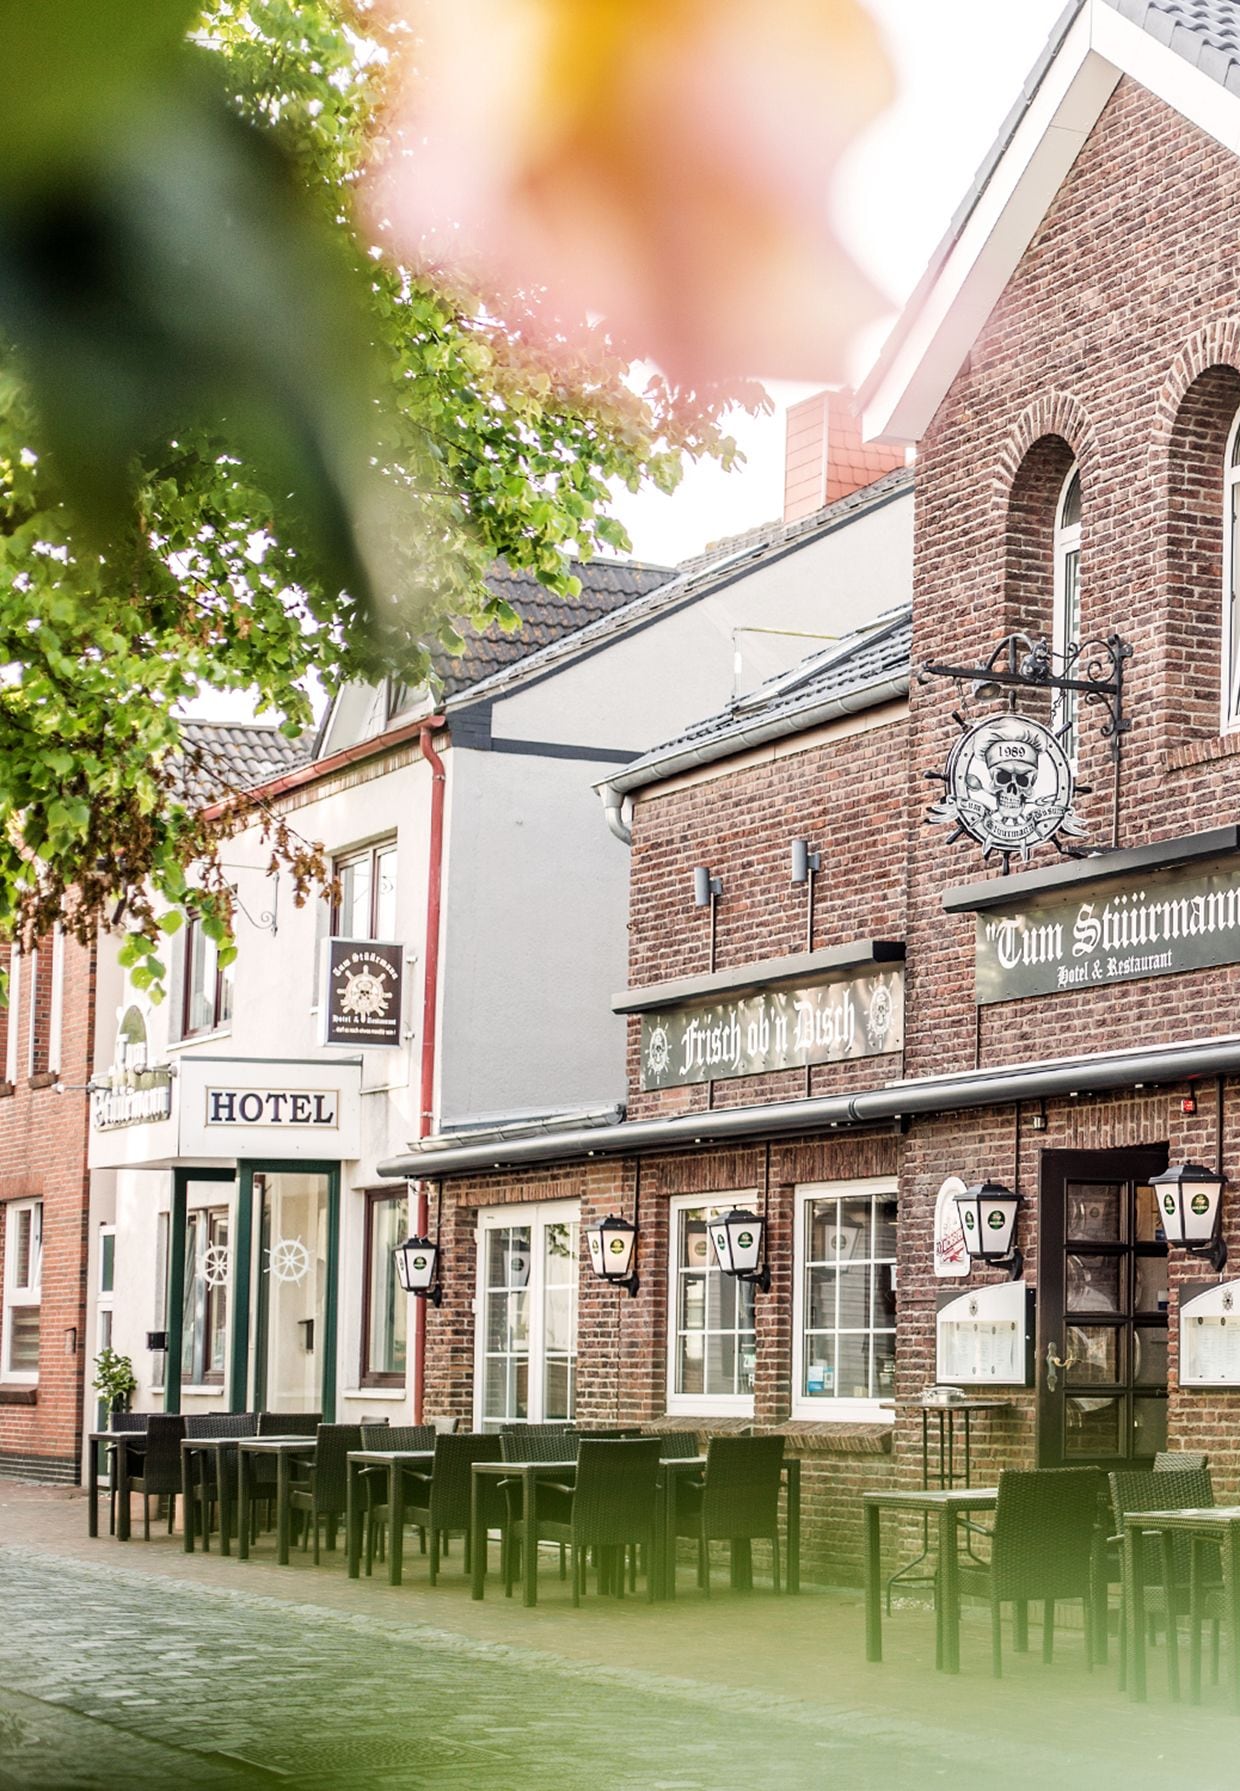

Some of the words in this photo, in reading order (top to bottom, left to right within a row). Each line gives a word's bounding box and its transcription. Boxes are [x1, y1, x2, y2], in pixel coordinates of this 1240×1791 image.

[998, 746, 1026, 758] 1989
[1056, 960, 1089, 987] Hotel
[1092, 962, 1103, 980] &
[1106, 950, 1172, 979] Restaurant
[679, 1013, 740, 1075] Frisch
[747, 1008, 788, 1057] ob'n
[793, 990, 856, 1053] Disch
[210, 1092, 334, 1124] HOTEL
